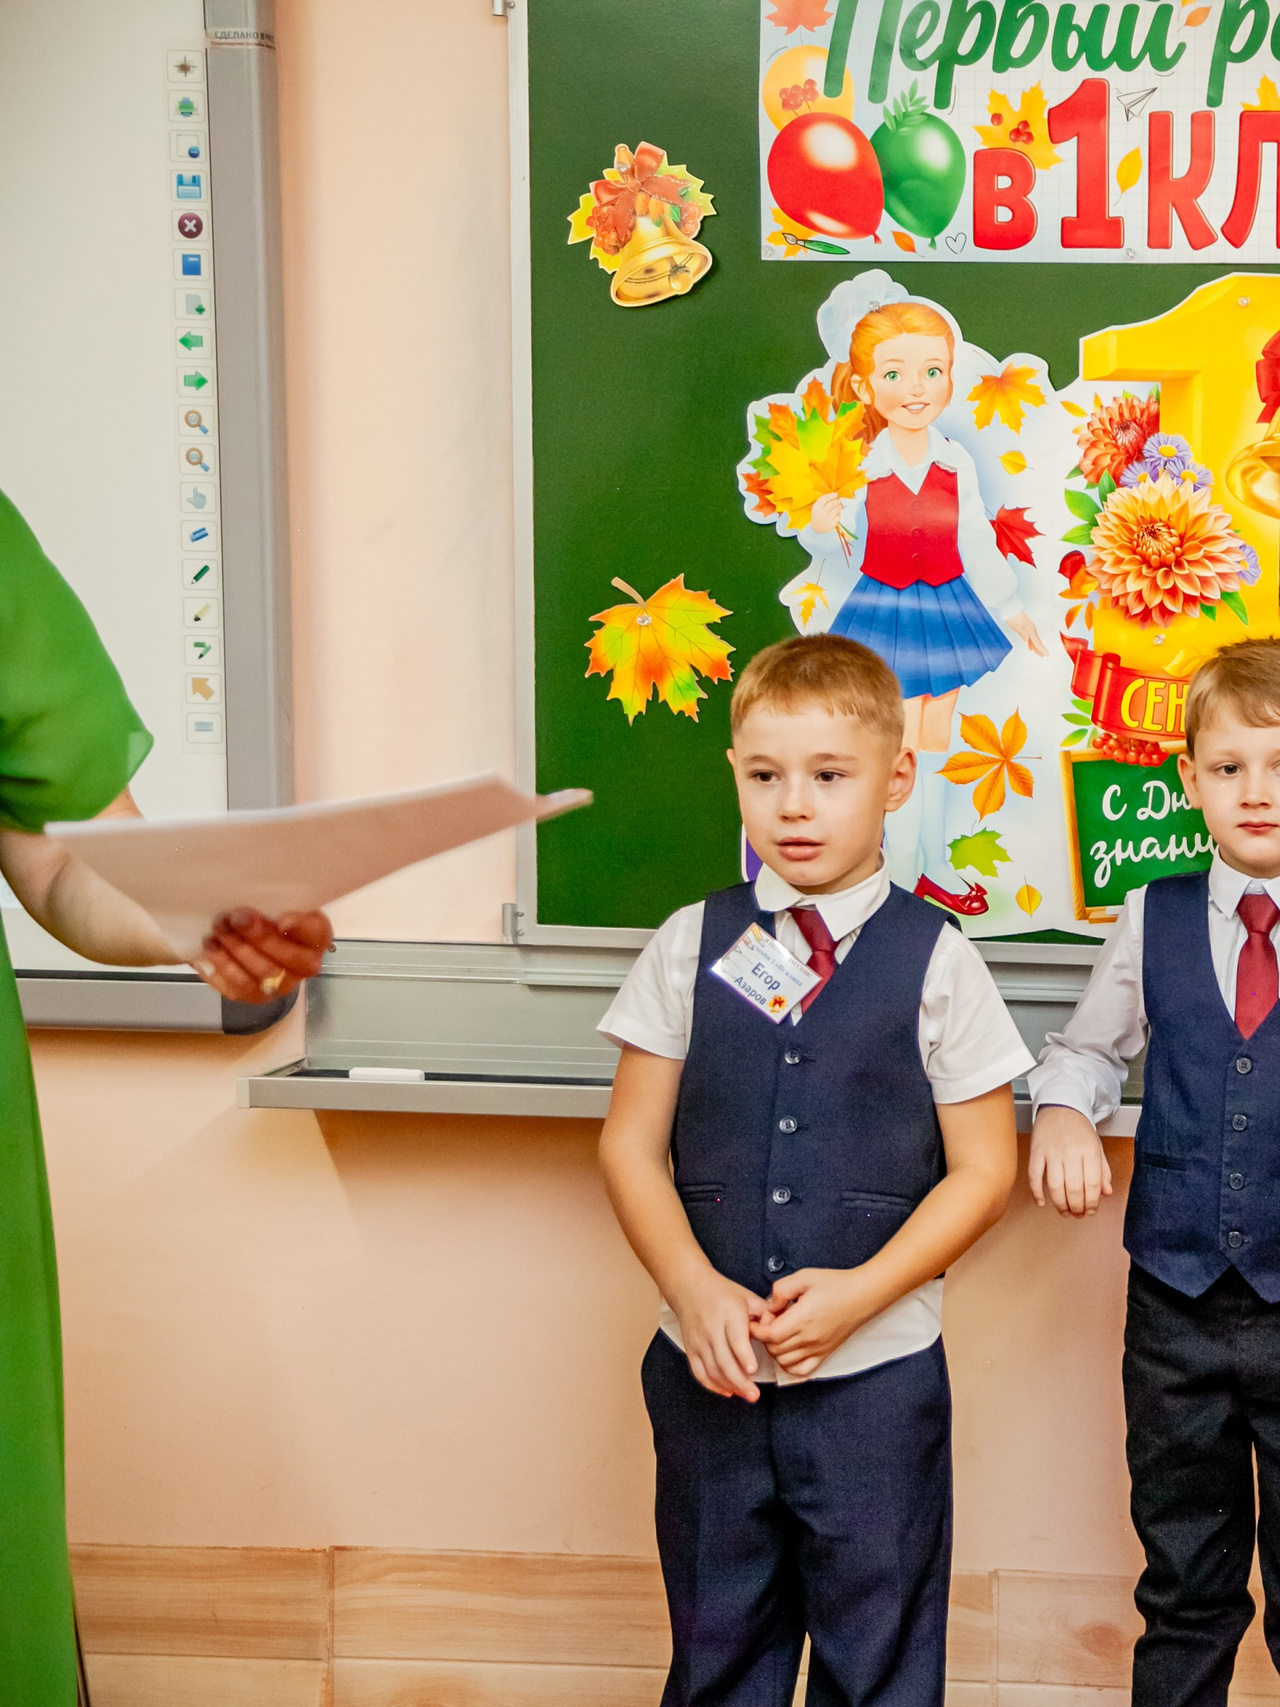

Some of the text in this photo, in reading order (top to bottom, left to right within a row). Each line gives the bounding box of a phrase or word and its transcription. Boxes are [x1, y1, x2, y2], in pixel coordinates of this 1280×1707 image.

[214, 30, 259, 40] СДЕЛАНО
[1047, 78, 1125, 249] 1
[1121, 678, 1188, 733] СЕН
[1102, 780, 1193, 821] С Дн
[1090, 832, 1216, 889] знани
[734, 976, 767, 1006] Азаров
[751, 962, 781, 991] Егор
